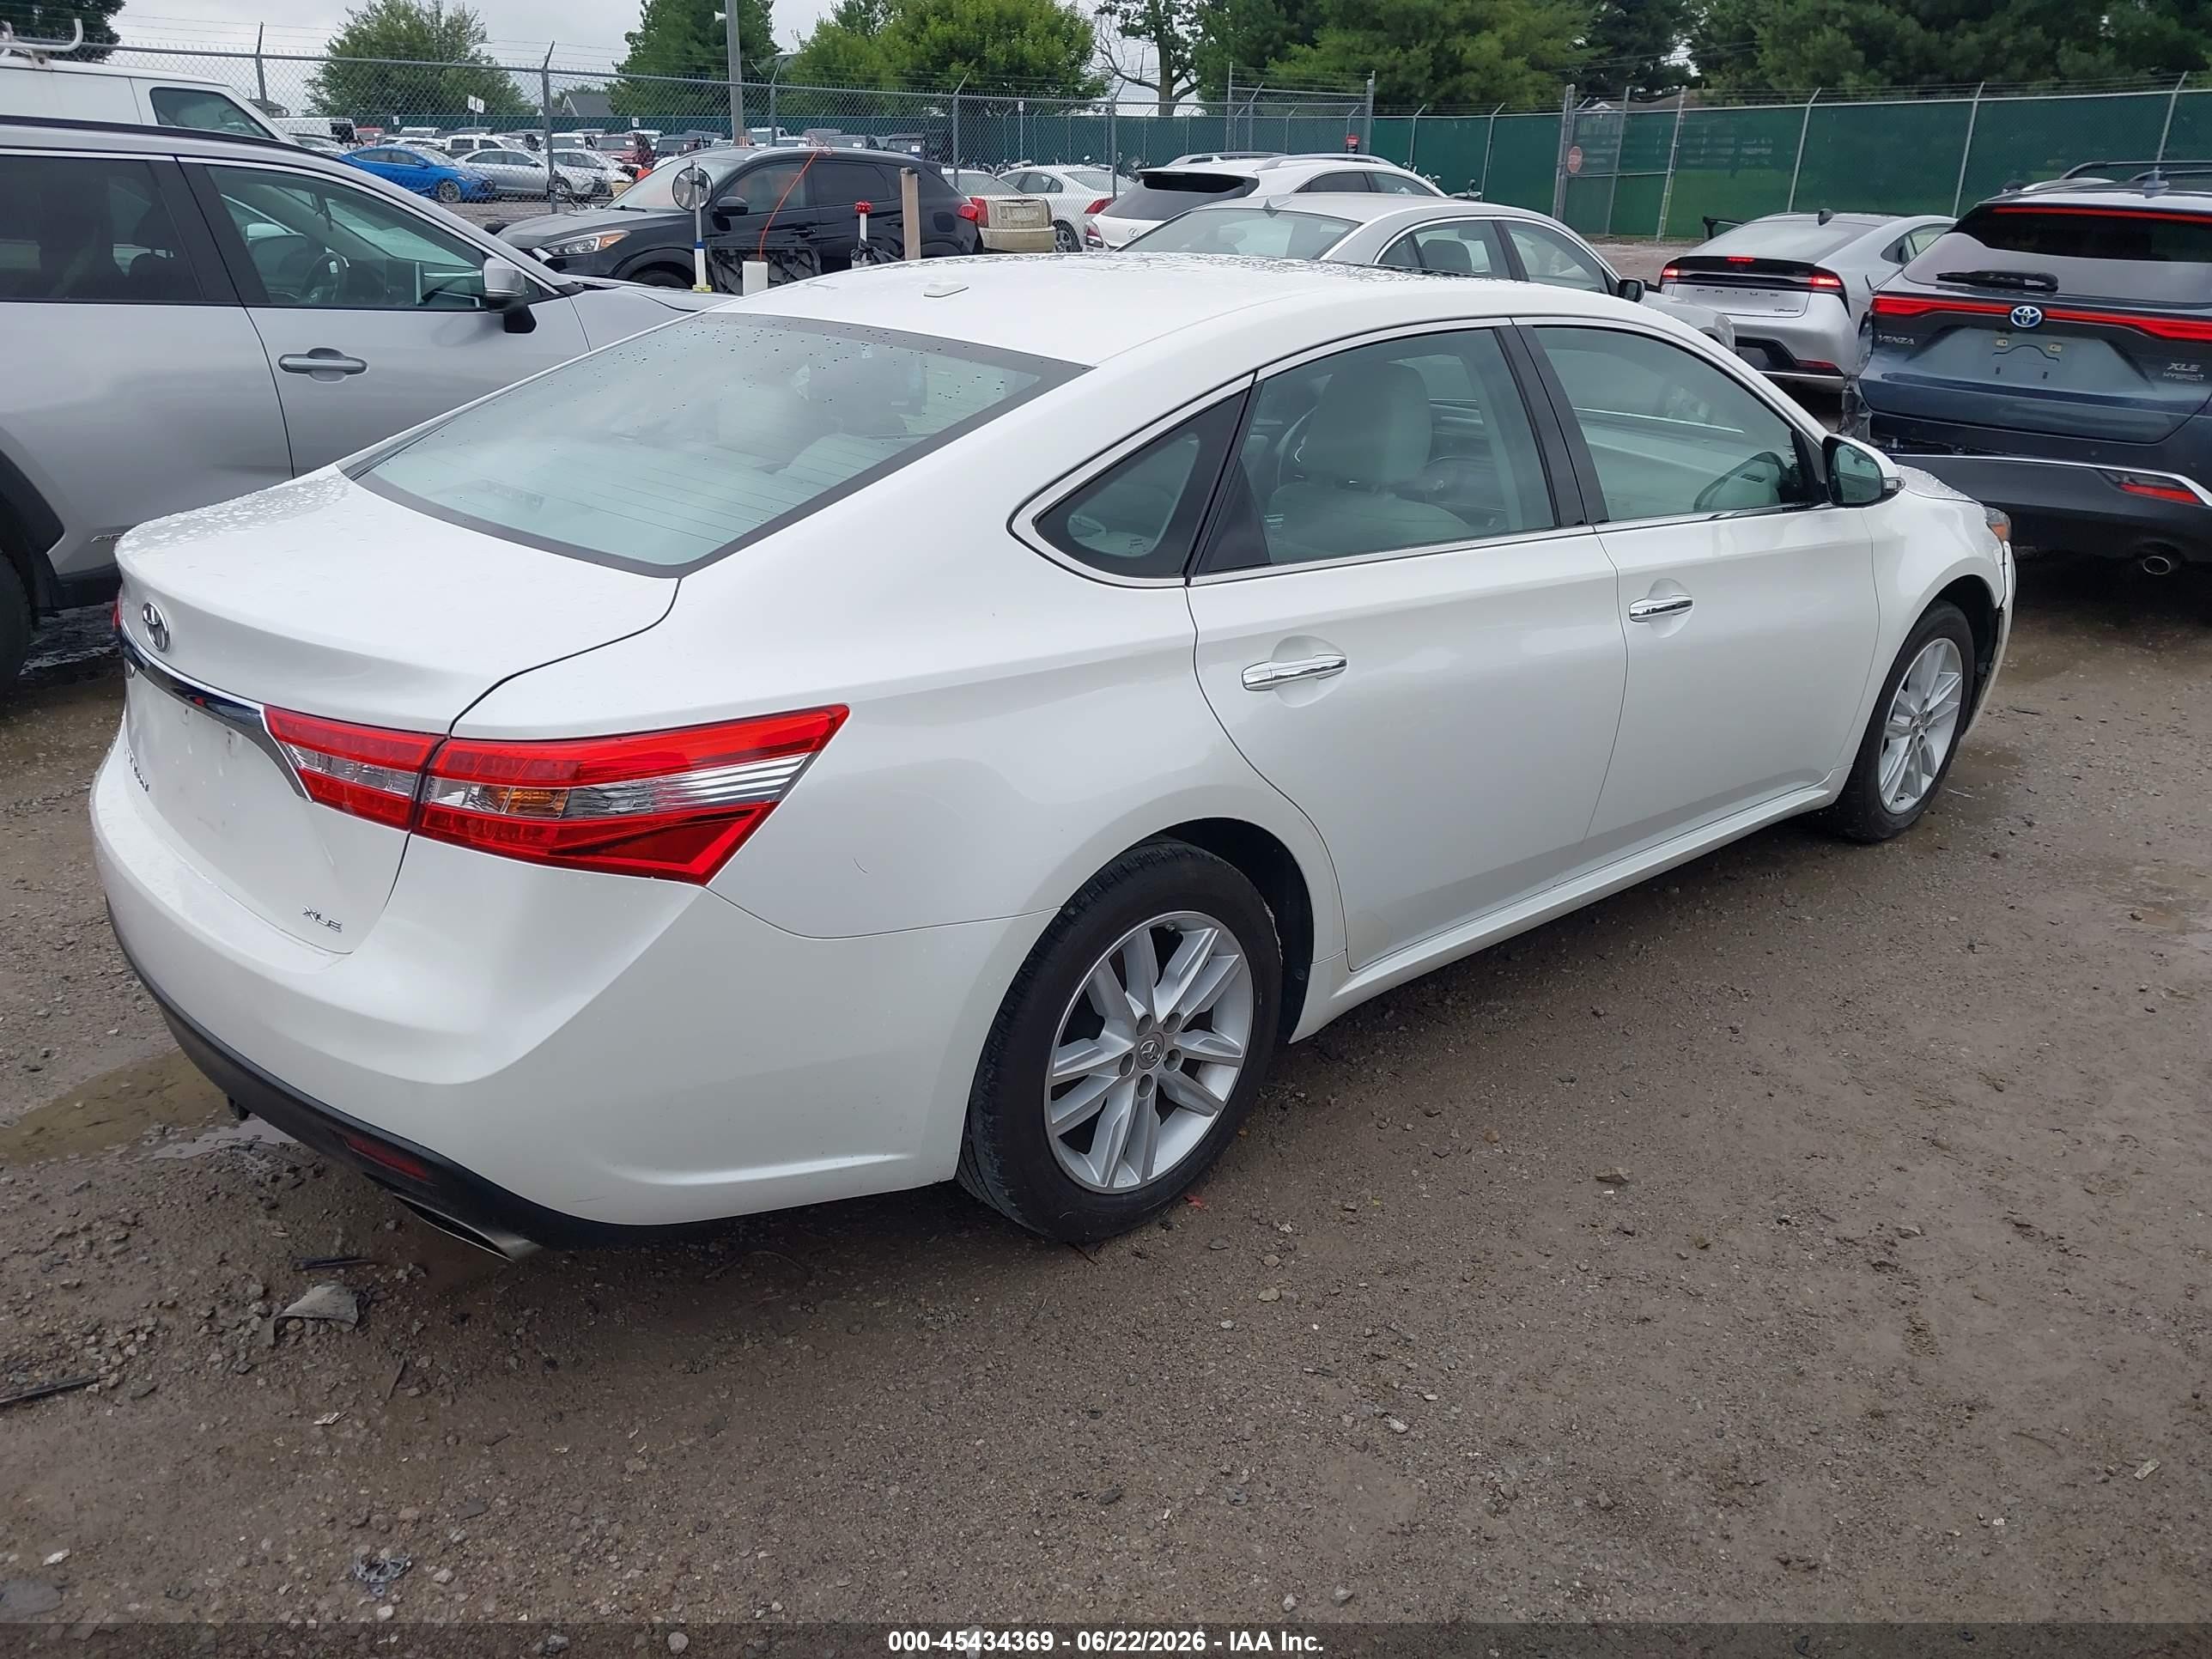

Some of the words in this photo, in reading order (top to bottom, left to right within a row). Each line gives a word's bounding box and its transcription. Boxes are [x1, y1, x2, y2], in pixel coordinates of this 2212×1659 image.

[1697, 288, 1779, 297] PRIUS
[1878, 335, 1915, 344] VENZA
[2166, 362, 2201, 372] XLE
[302, 906, 343, 933] XLE
